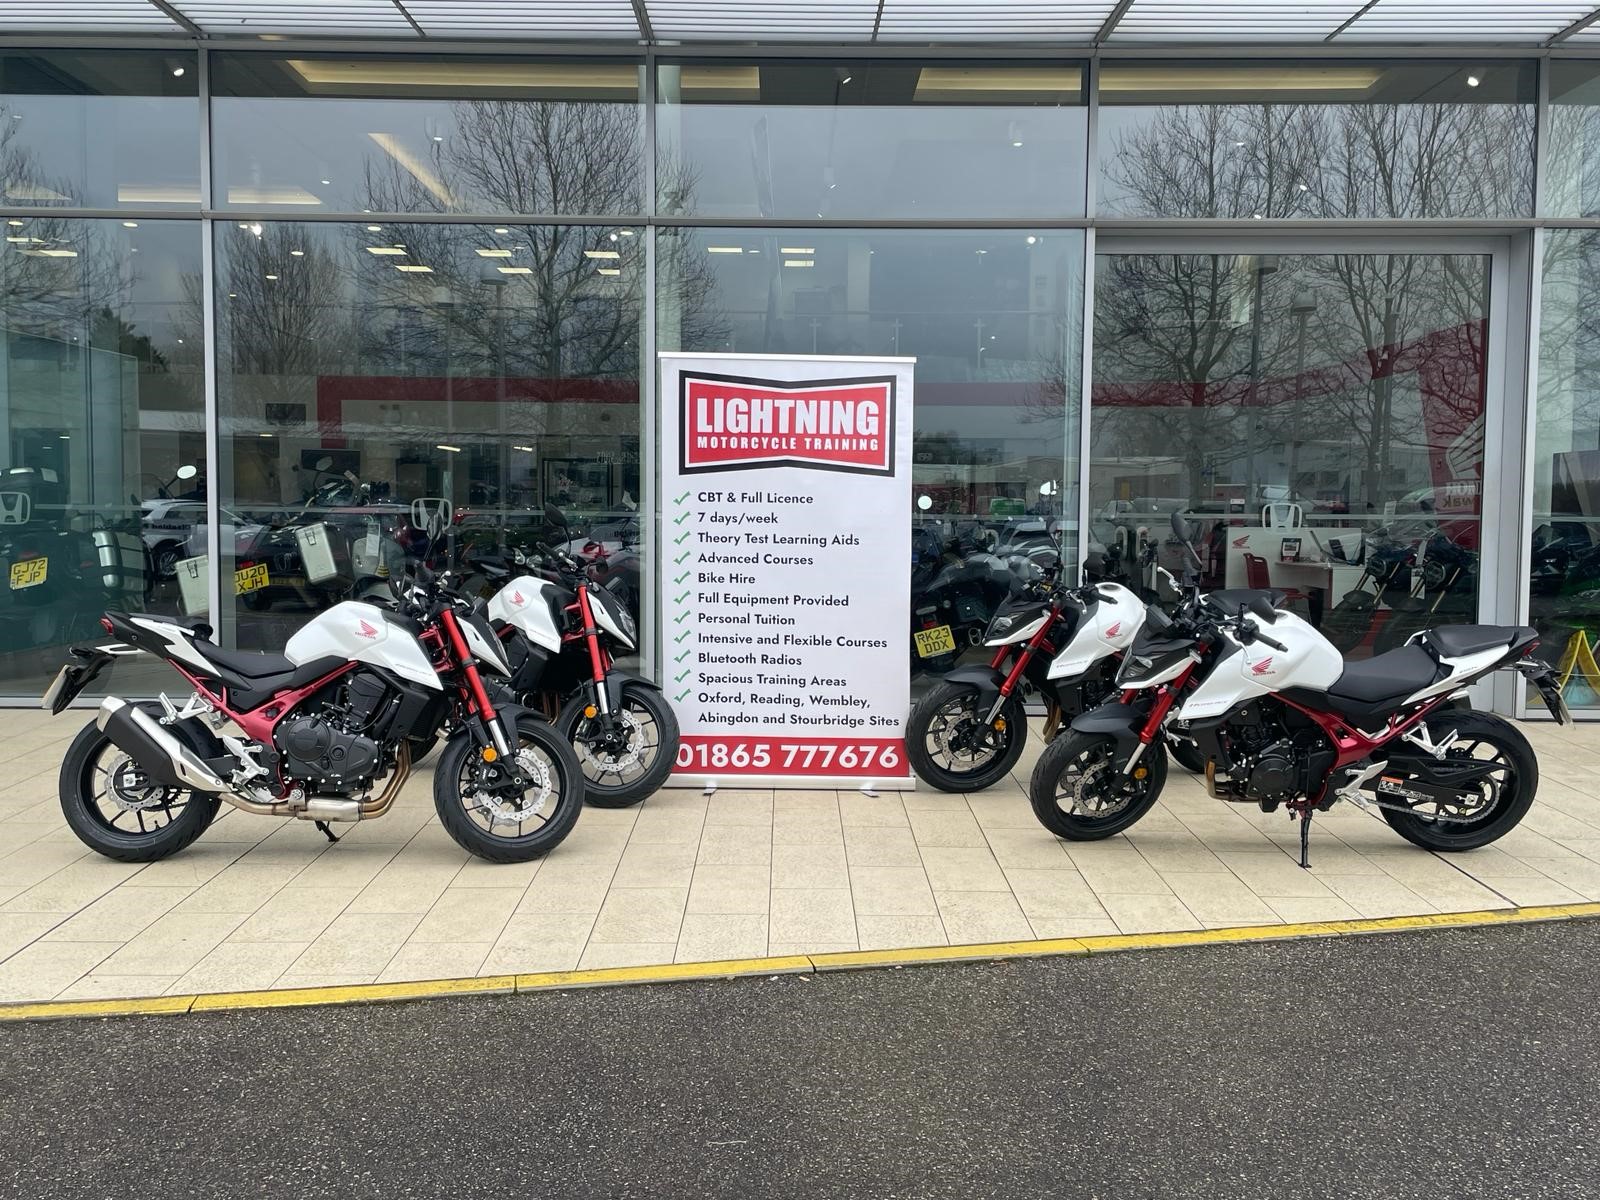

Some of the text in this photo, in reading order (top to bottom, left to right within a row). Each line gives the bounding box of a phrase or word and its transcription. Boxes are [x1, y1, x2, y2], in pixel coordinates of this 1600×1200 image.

[698, 398, 879, 435] LIGHTNING
[698, 437, 878, 450] MOTORCYCLE TRAINING
[698, 492, 813, 503] CBT & Full Licence
[698, 512, 778, 525] 7 days/week
[698, 532, 859, 548] Theory Test Learning Aids
[698, 552, 813, 565] Advanced Courses
[13, 560, 45, 575] GJ72
[16, 572, 40, 585] FJP
[238, 577, 263, 592] XJH
[699, 572, 755, 583] Bike Hire
[699, 592, 848, 607] Full Equipment Provided
[699, 613, 795, 625] Personal Tuition
[699, 633, 887, 647] Intensive and Flexible Courses
[917, 627, 950, 644] RK23
[924, 639, 949, 654] DDX
[699, 652, 801, 665] Bluetooth Radios
[699, 673, 846, 688] Spacious Training Areas
[698, 692, 870, 709] Oxford, Reading, Wembley,
[698, 712, 899, 728] Abingdon and Stourbridge Sites
[676, 744, 898, 768] 01865 777676
